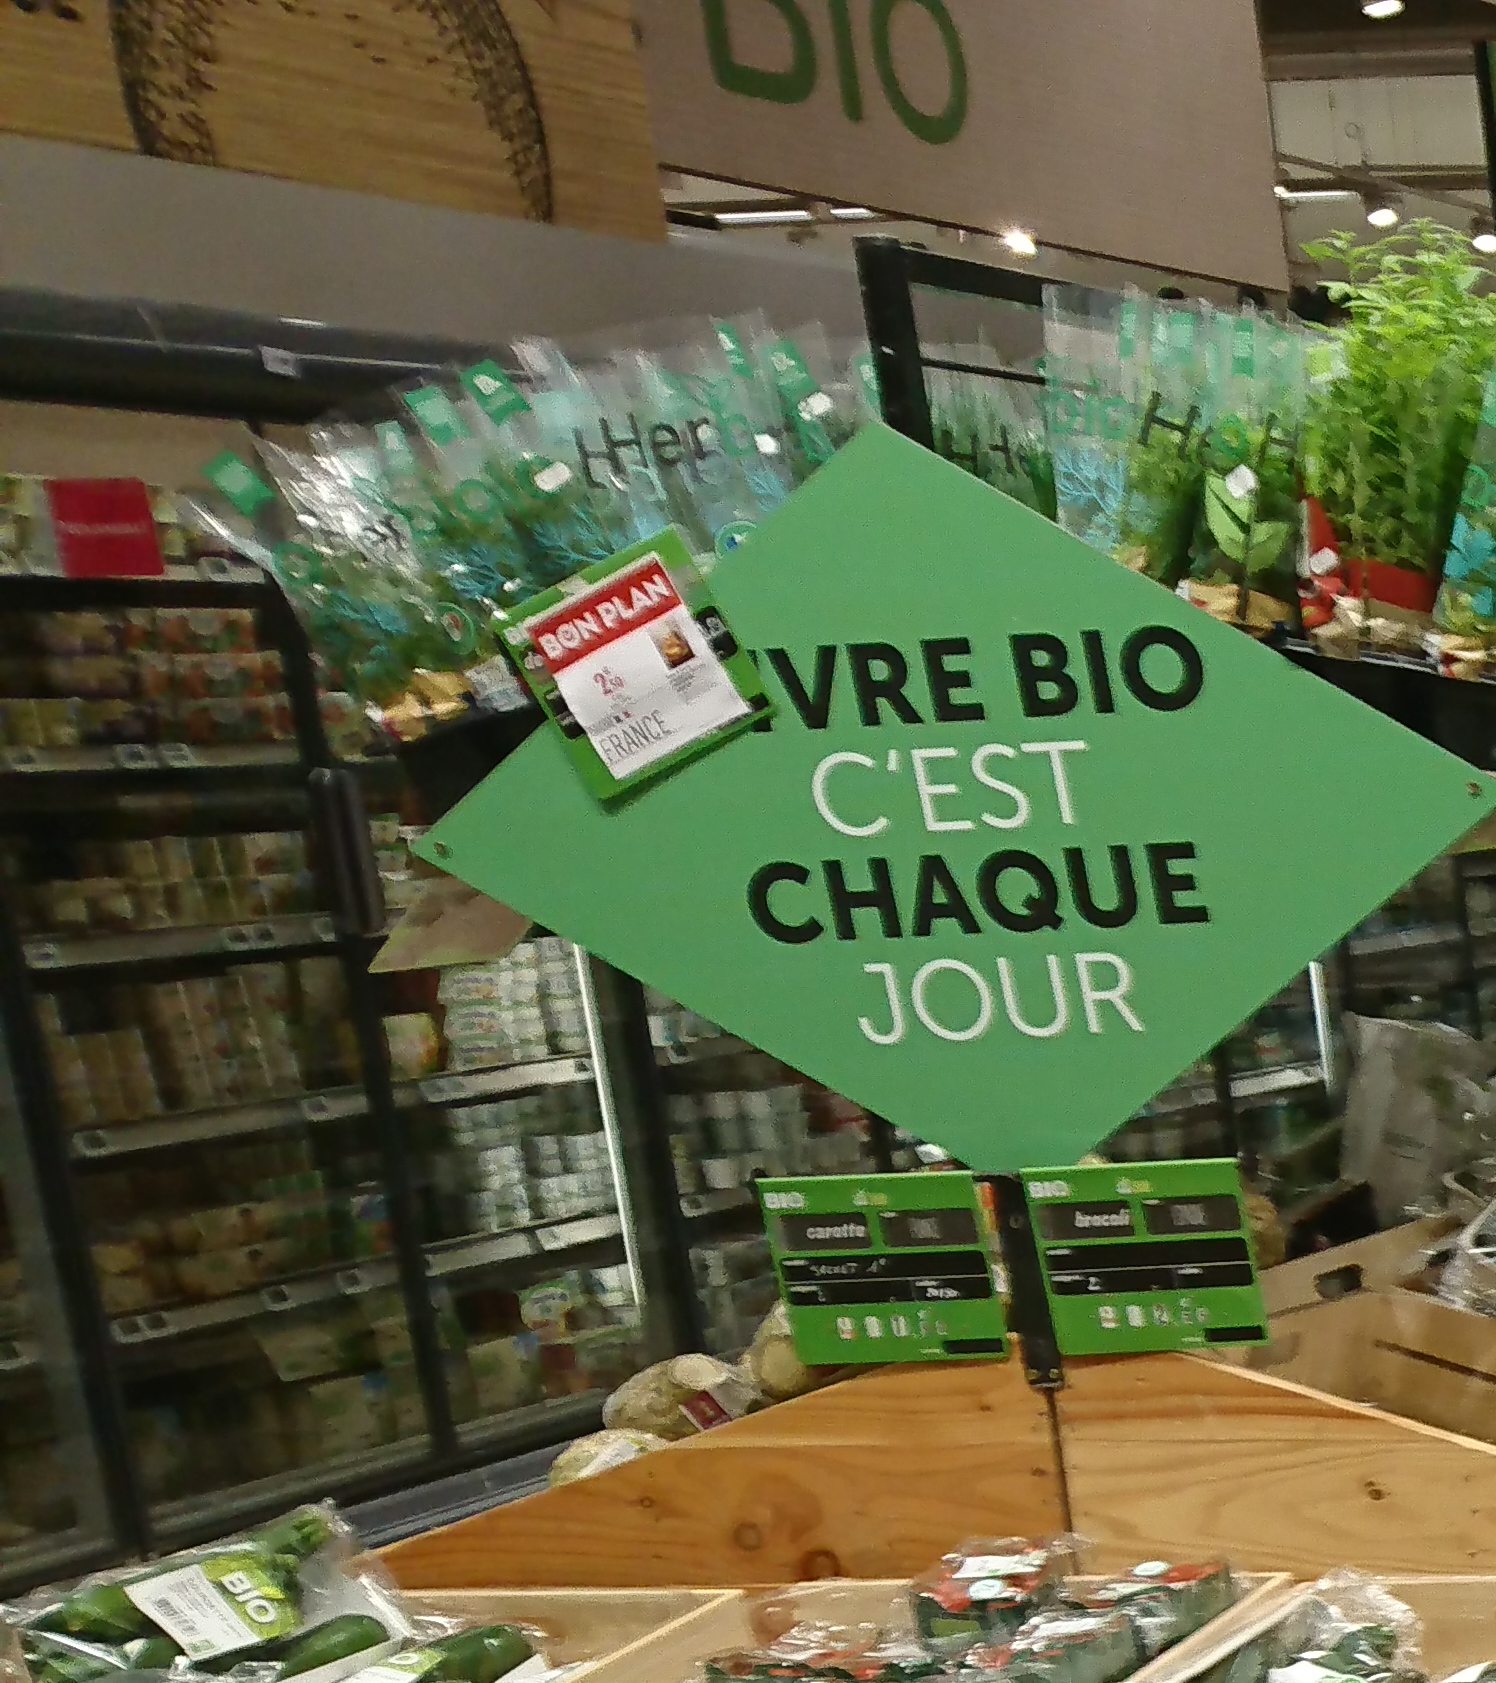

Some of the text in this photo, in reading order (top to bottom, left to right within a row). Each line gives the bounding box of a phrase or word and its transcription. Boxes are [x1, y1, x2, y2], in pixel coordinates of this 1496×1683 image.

[537, 573, 672, 660] BON PLAN
[1010, 625, 1203, 717] BIO
[598, 709, 674, 765] FRANCE
[811, 738, 1089, 837] C'EST
[747, 842, 1210, 944] CHAQUE
[857, 952, 1144, 1045] JOUR
[221, 1569, 277, 1625] BIO
